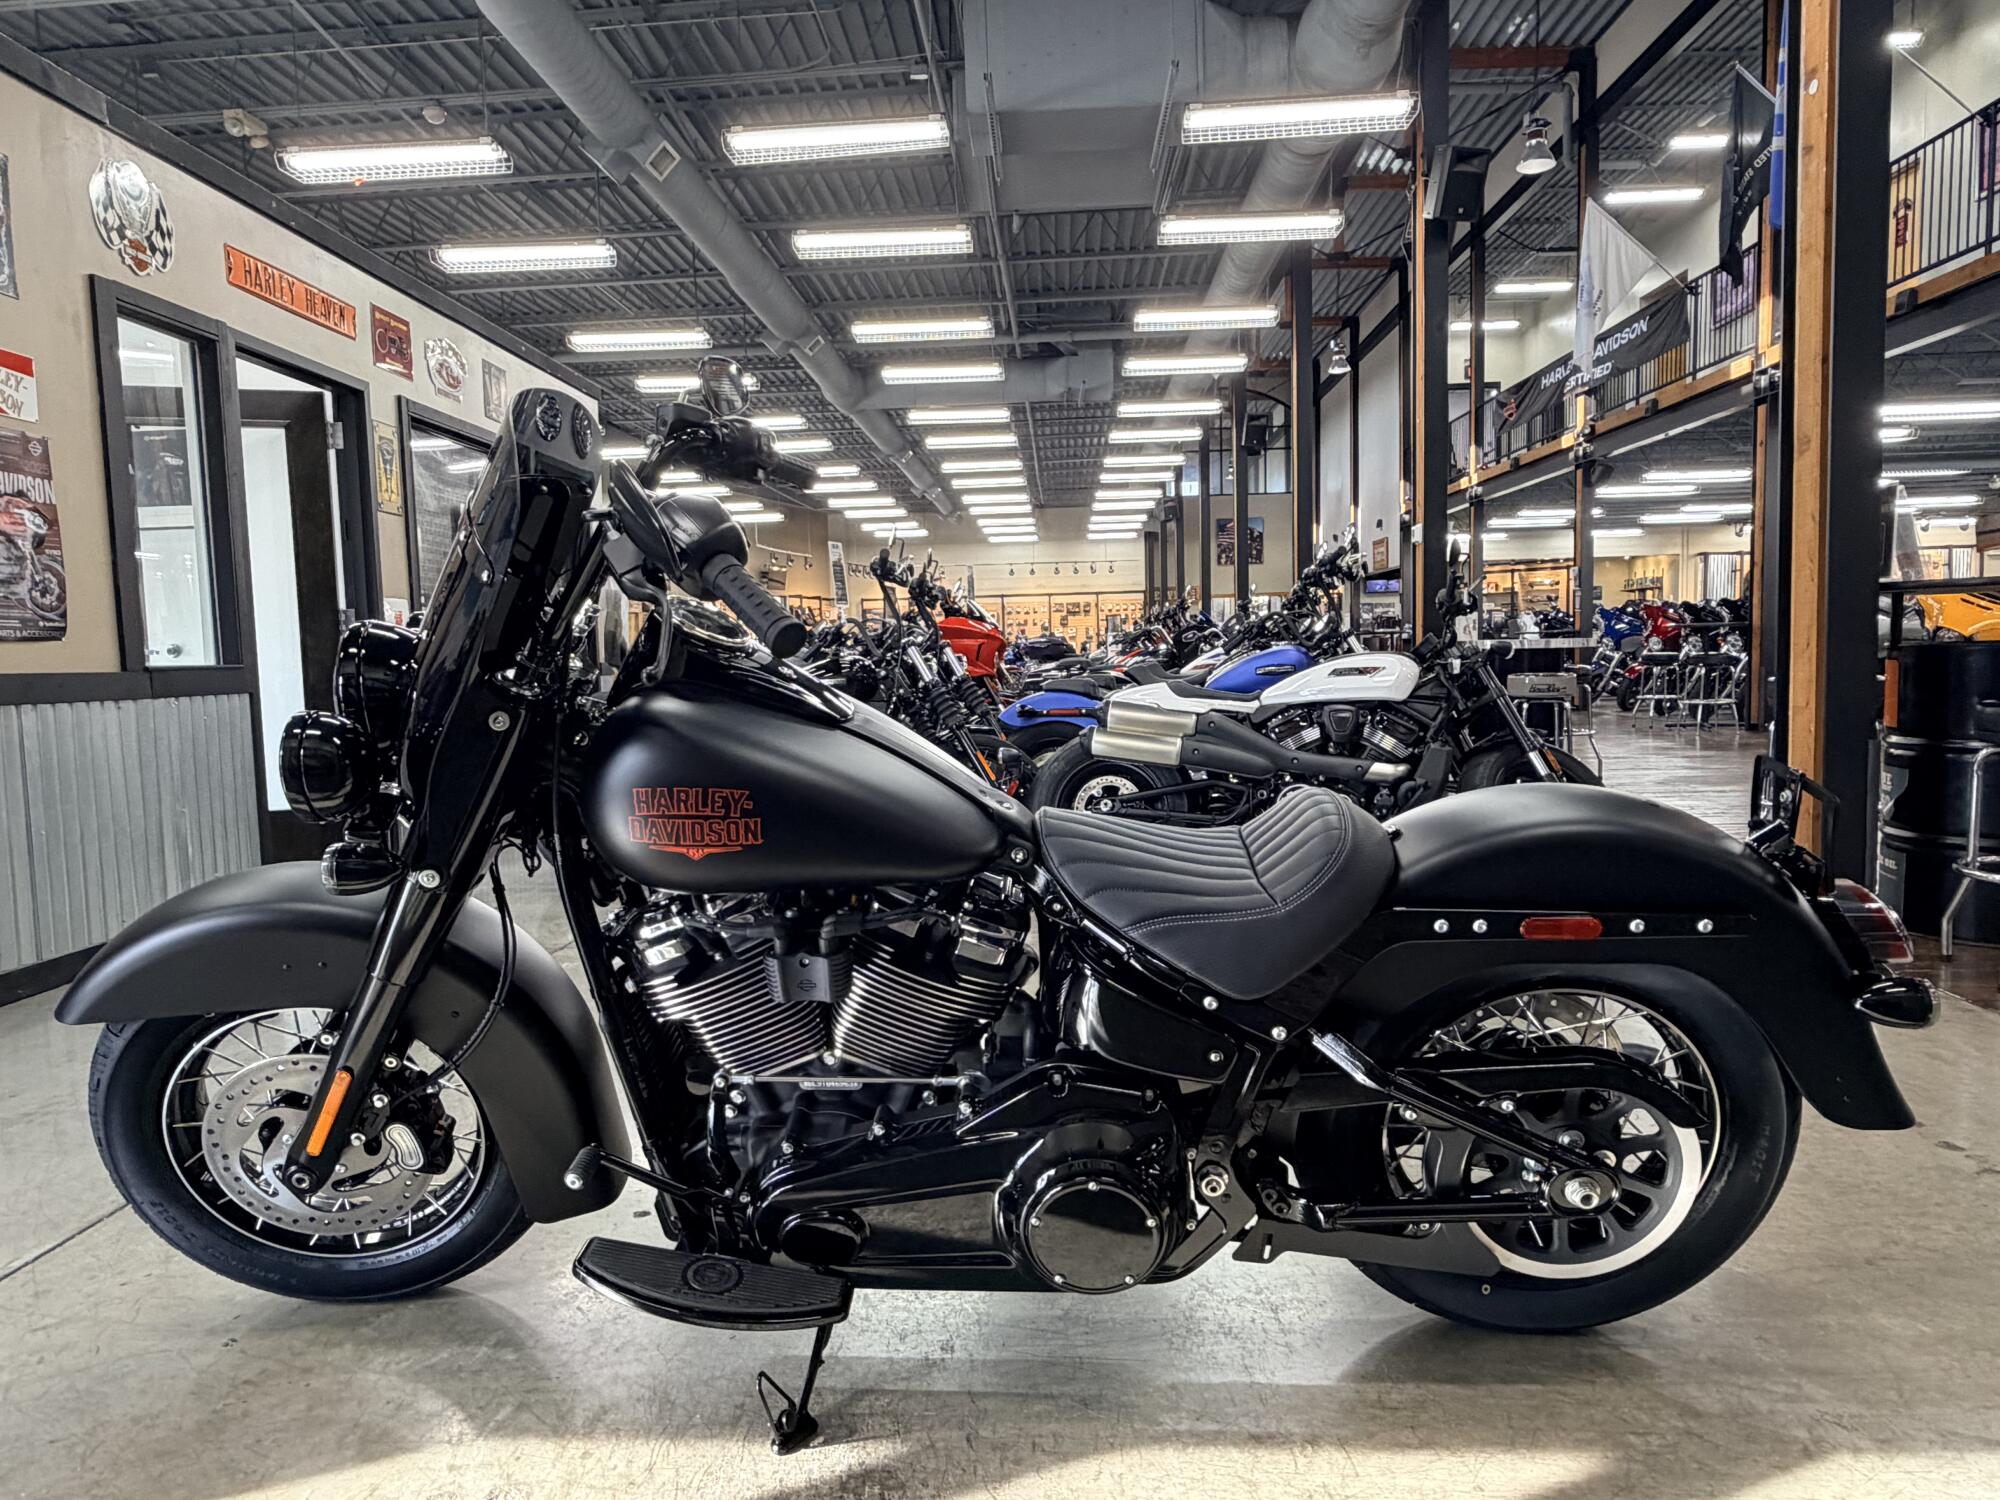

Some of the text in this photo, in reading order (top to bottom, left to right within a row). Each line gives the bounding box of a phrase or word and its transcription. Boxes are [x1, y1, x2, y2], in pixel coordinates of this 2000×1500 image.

[243, 255, 295, 305] HARLEY
[304, 285, 347, 331] HEAVEN
[632, 787, 753, 817] HARLEY-
[628, 816, 764, 845] DAVIDSON
[686, 848, 705, 858] USA
